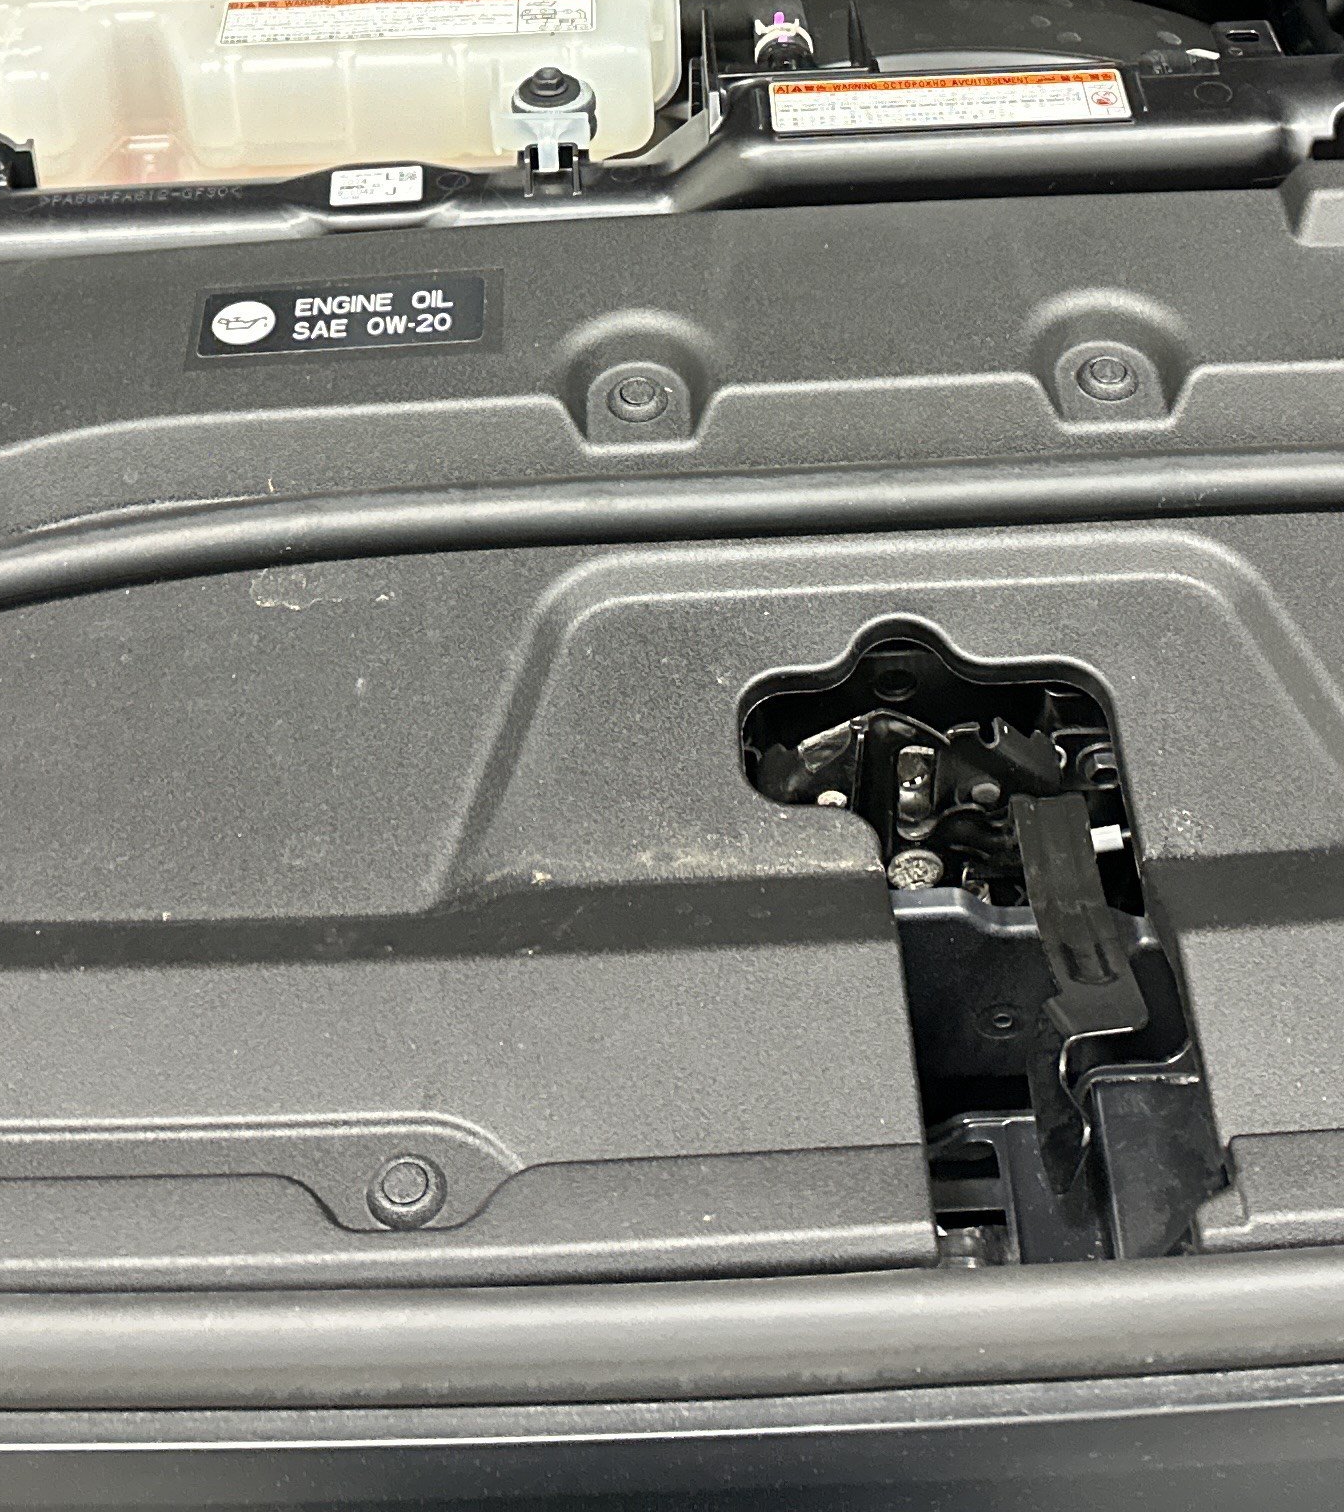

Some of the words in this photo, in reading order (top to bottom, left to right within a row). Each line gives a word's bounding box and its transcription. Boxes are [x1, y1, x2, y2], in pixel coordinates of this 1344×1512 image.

[294, 292, 394, 318] ENGINE
[411, 289, 454, 311] OIL
[292, 318, 348, 341] SAE
[366, 312, 453, 336] 0W-20
